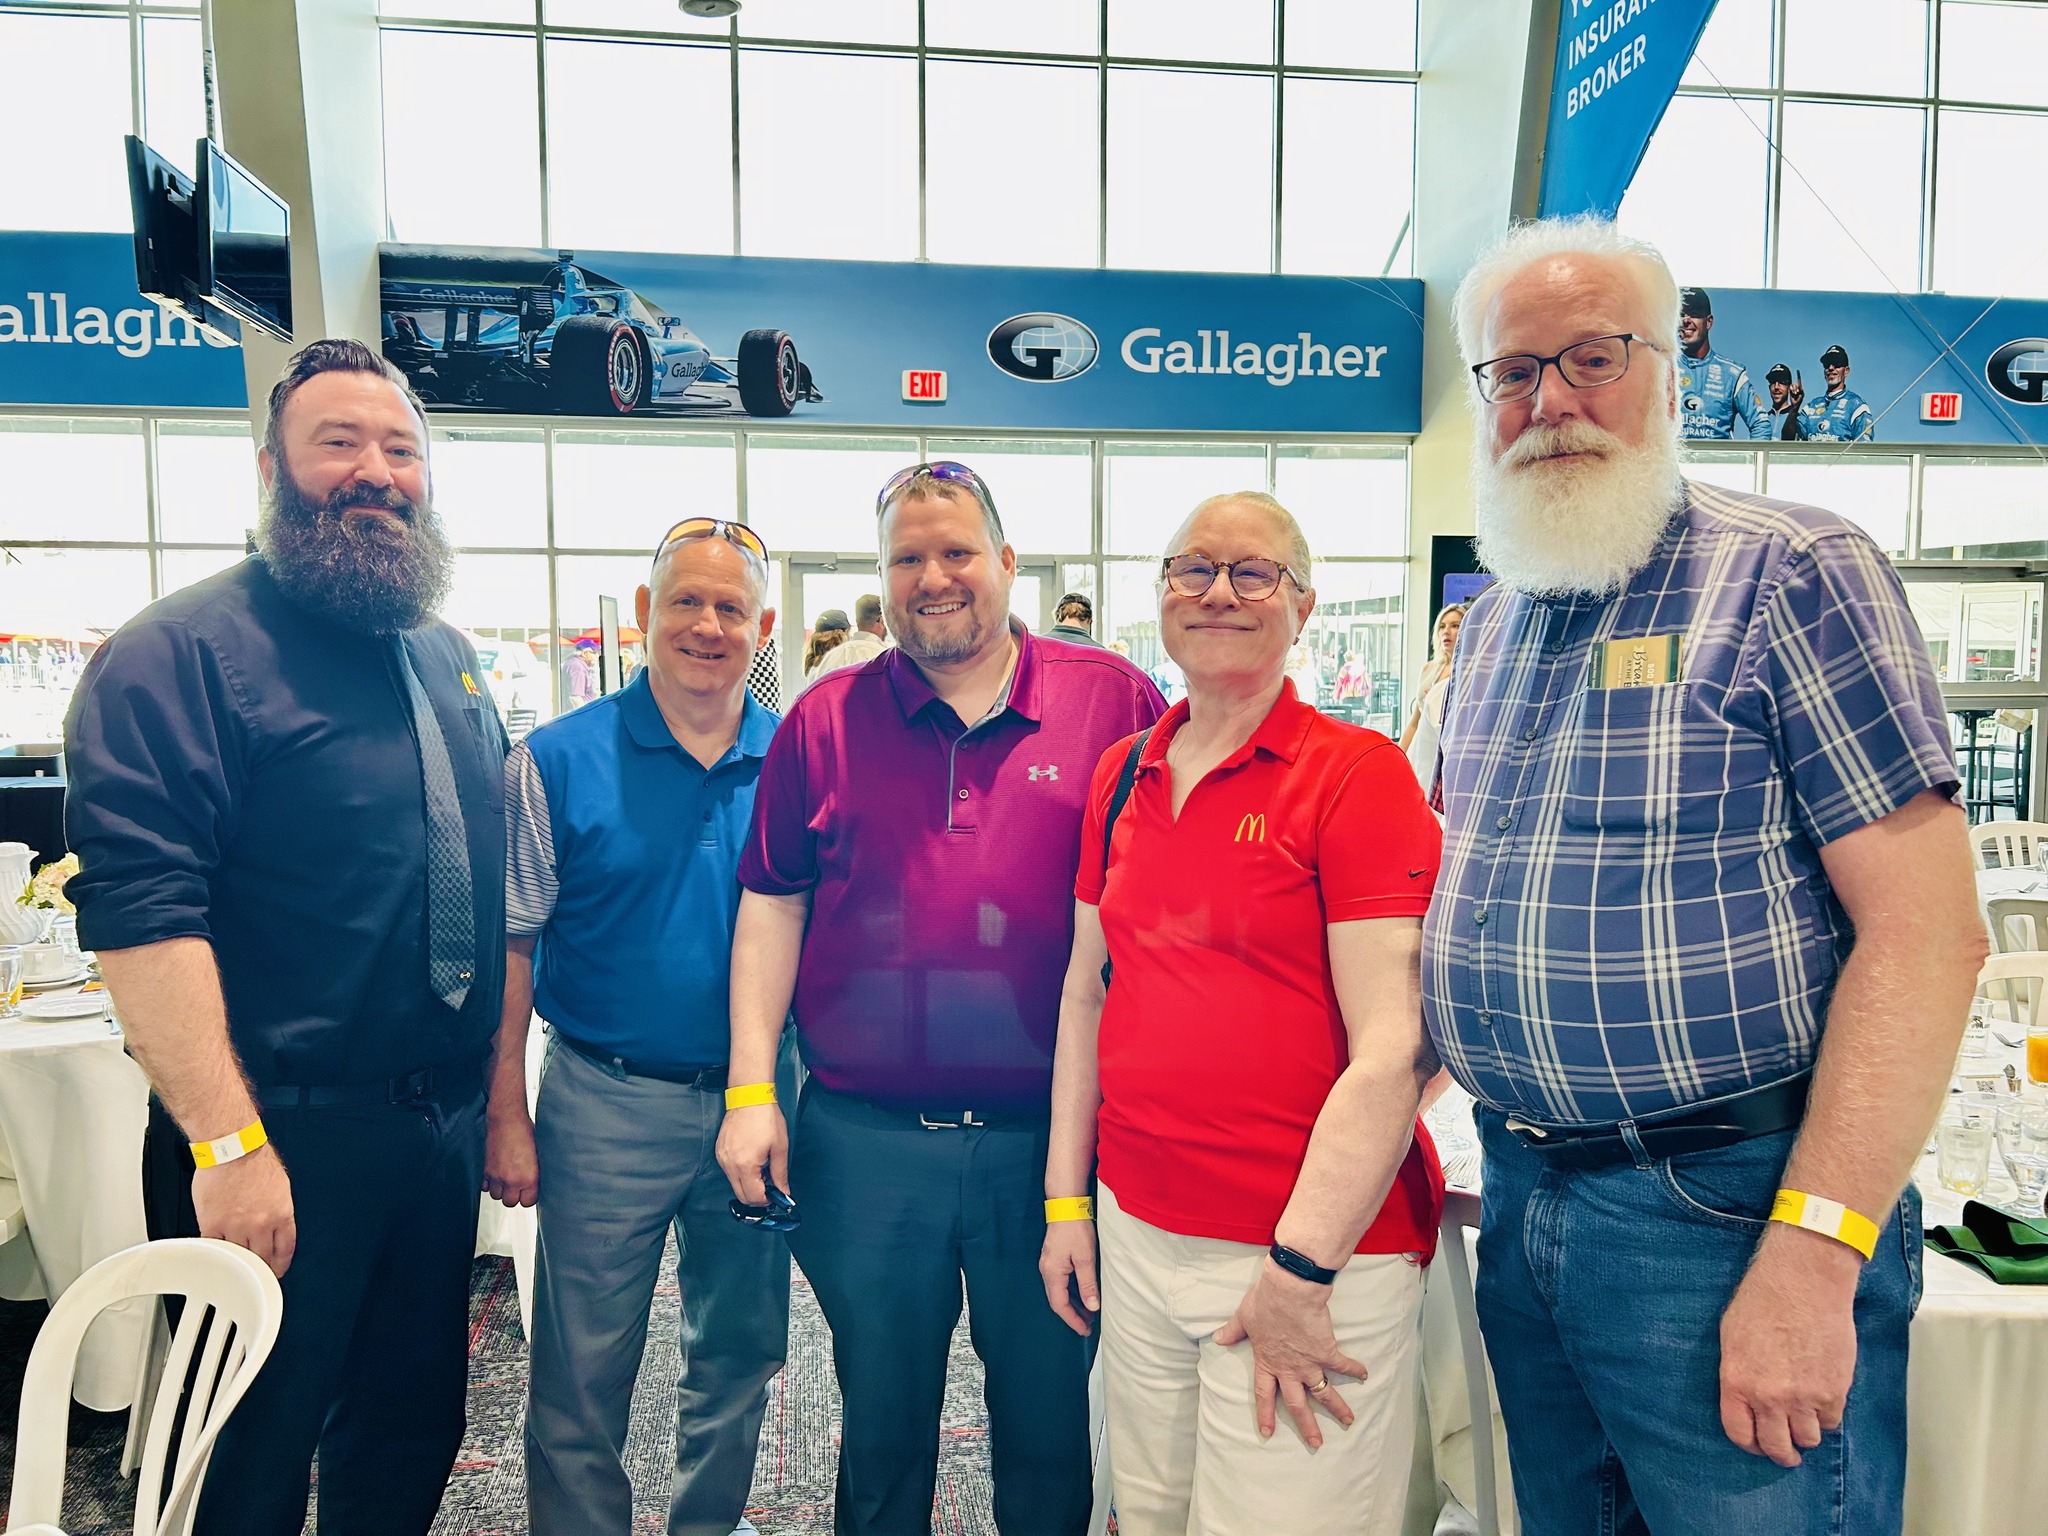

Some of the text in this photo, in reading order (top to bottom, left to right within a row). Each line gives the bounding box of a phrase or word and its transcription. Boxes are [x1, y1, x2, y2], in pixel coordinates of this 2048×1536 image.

[1566, 33, 1647, 120] BROKER
[1121, 327, 1388, 386] Gallagher
[909, 371, 942, 398] EXIT
[1929, 394, 1959, 419] EXIT
